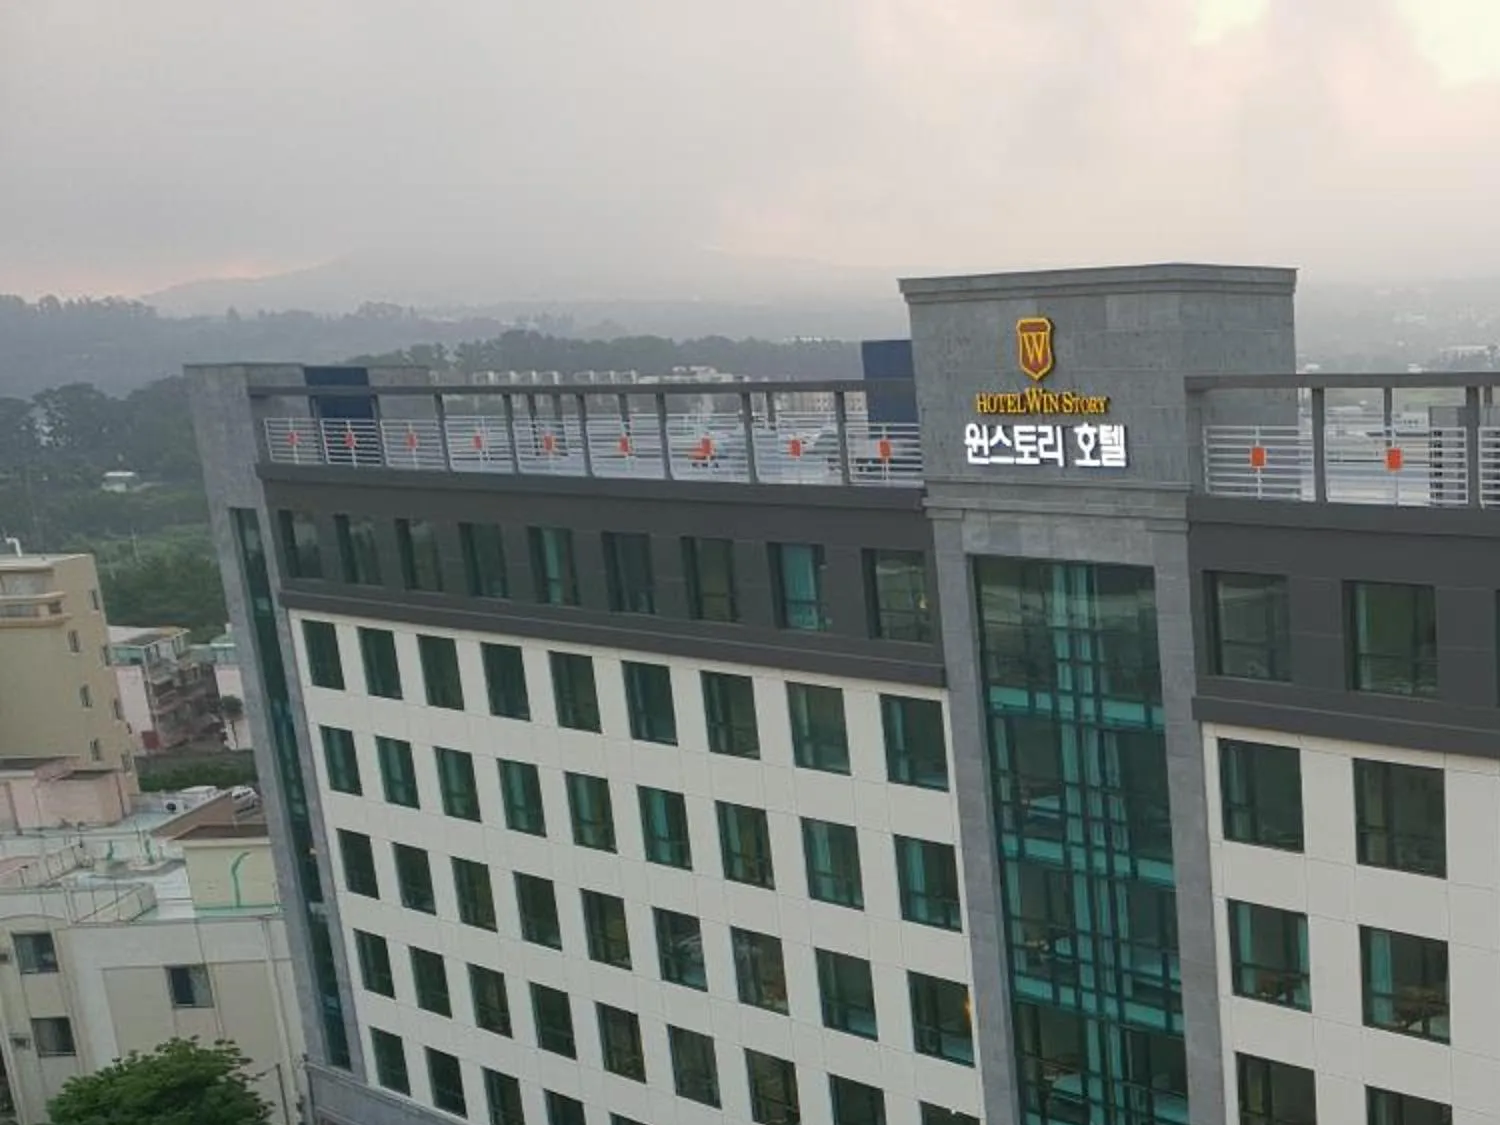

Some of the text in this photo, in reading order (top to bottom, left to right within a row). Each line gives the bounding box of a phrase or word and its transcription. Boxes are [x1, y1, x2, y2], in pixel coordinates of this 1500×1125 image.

[1022, 332, 1046, 364] W
[976, 392, 1025, 415] HOTEL
[964, 423, 1127, 468] 윈스토리 호텔
